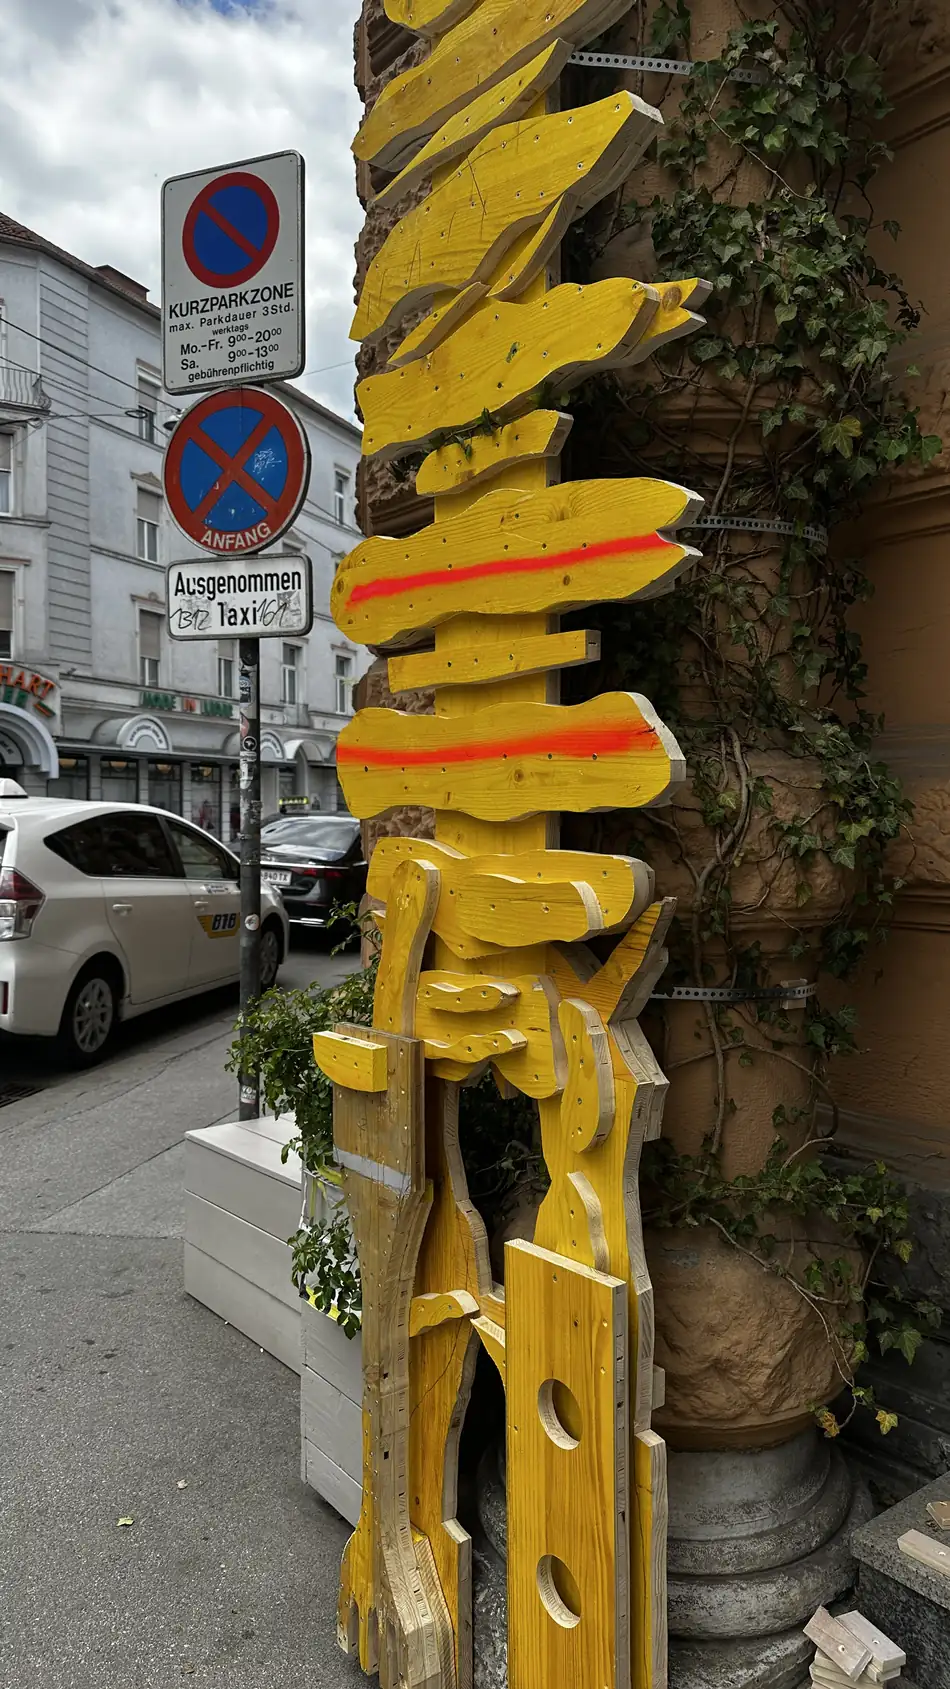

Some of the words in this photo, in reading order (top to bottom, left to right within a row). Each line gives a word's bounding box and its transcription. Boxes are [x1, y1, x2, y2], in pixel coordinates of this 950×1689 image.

[169, 282, 294, 319] KURZPARKZONE
[169, 321, 194, 333] max.
[200, 310, 257, 327] Parkdauer
[212, 323, 249, 336] werktags
[180, 338, 223, 355] Mo.-Fr.
[180, 357, 200, 370] Sa.
[188, 360, 274, 383] gebührenpflichtig
[201, 522, 271, 551] ANFANG
[174, 570, 301, 600] Ausgenommen
[217, 600, 257, 626] Taxi
